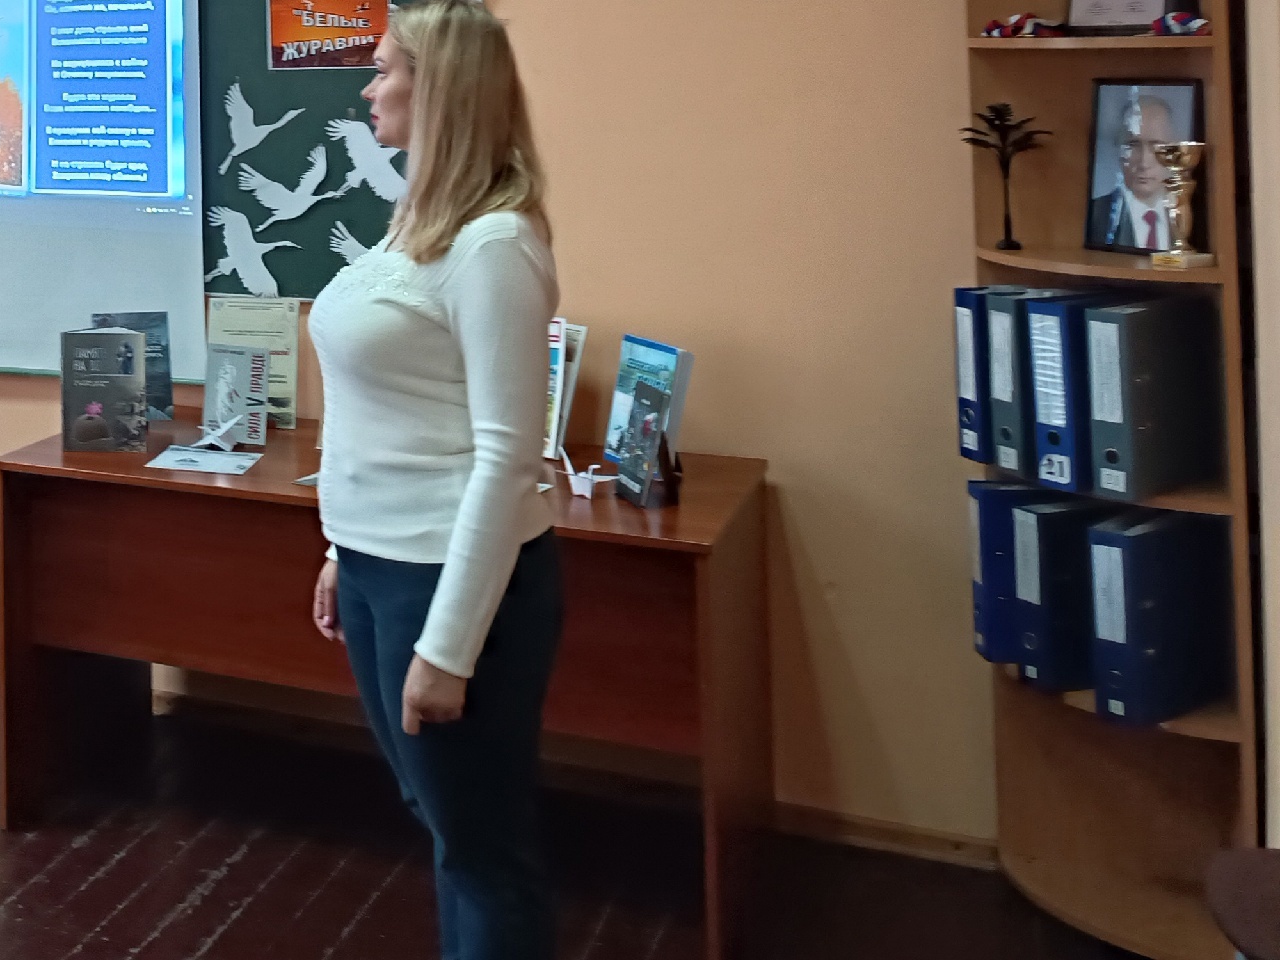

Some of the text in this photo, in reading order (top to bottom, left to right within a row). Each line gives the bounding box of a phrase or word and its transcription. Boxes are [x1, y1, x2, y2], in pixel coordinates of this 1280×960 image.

[292, 9, 371, 28] "БЕЛЫЕ
[250, 353, 266, 393] ПРАВДЕ
[247, 412, 261, 439] СИЛА
